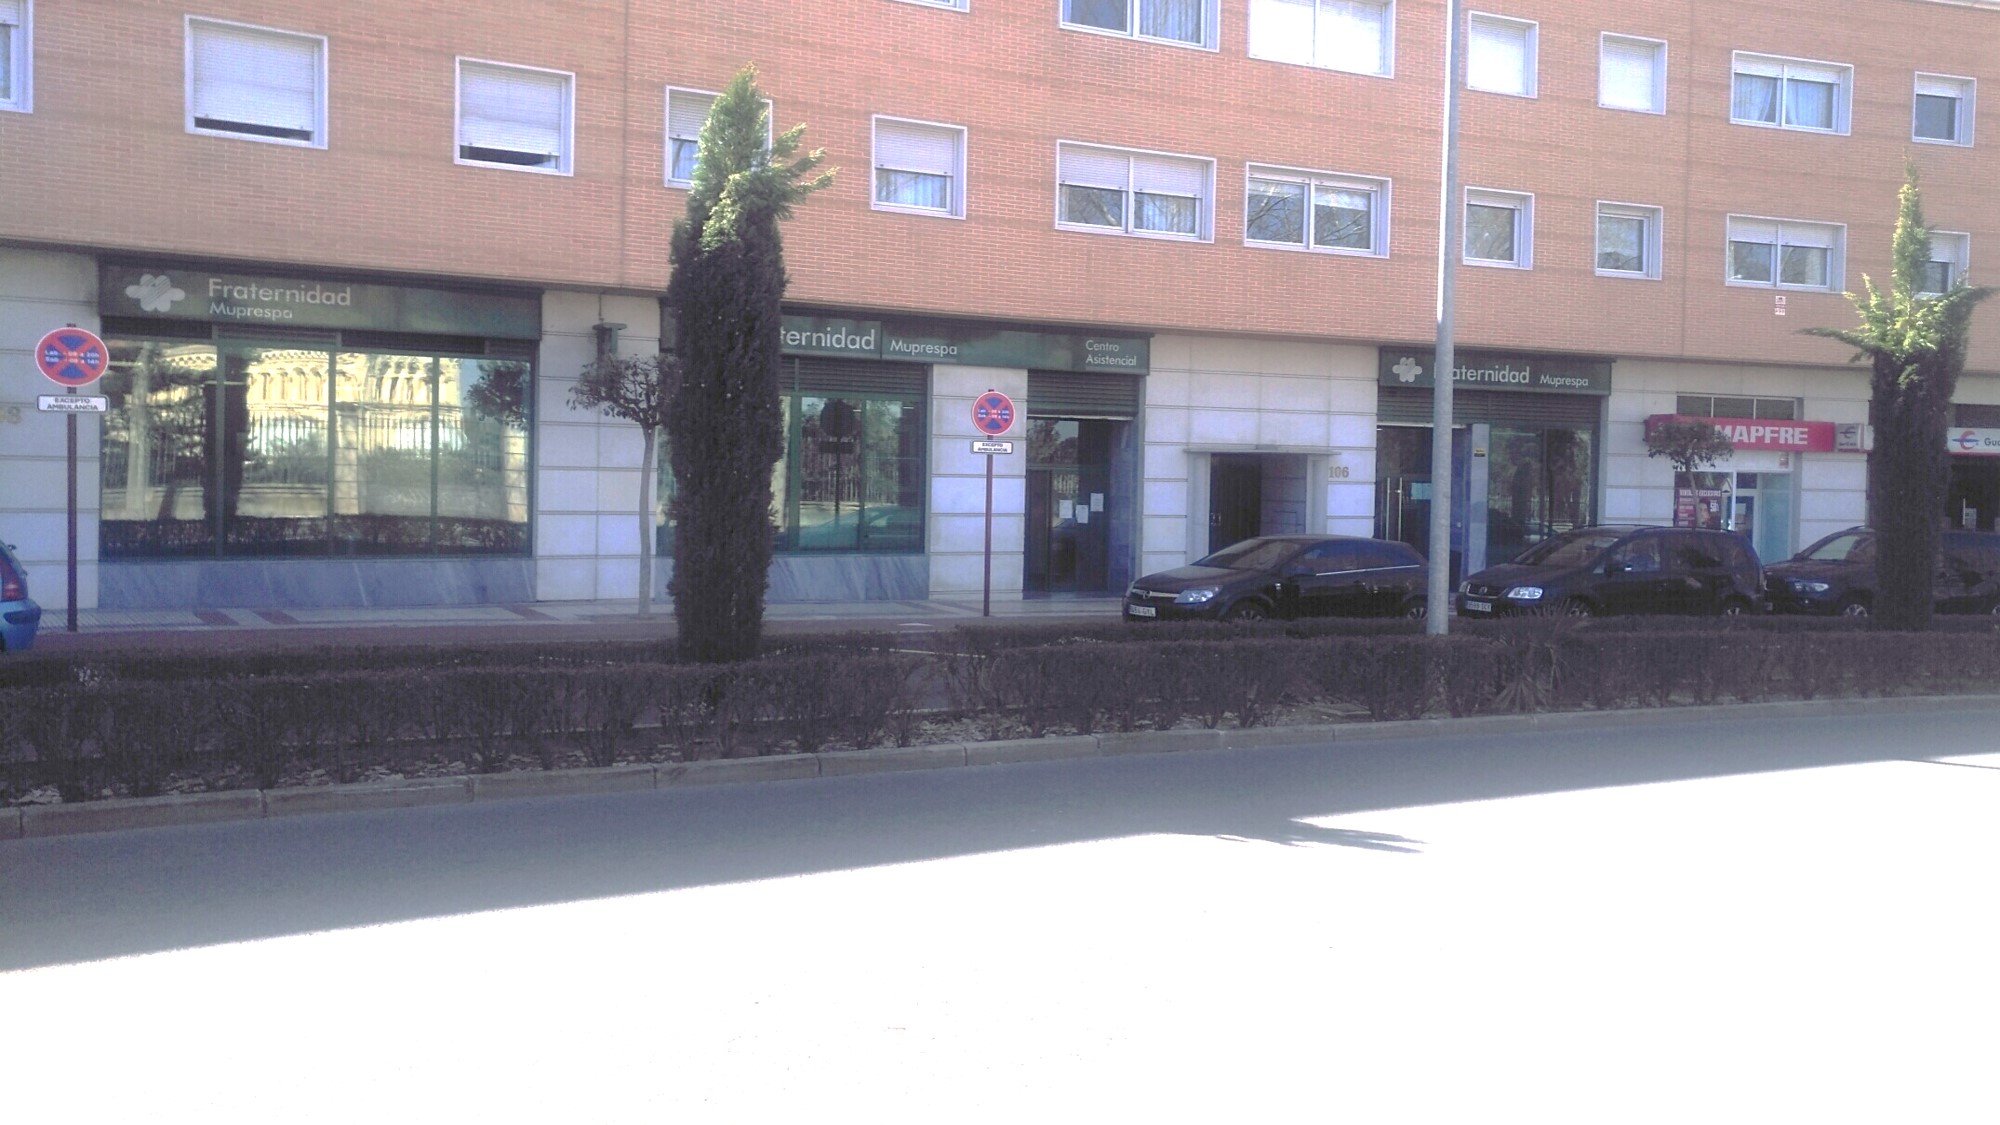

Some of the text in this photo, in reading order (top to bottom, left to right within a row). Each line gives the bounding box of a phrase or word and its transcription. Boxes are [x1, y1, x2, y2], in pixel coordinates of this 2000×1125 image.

[208, 278, 351, 306] Fraternidad
[209, 301, 293, 320] Muprespa
[780, 325, 957, 357] ternidad Muprespa
[1085, 340, 1120, 352] Centro
[1085, 353, 1137, 366] Asistencial
[1539, 374, 1589, 388] Muprespa
[1329, 466, 1350, 478] 106
